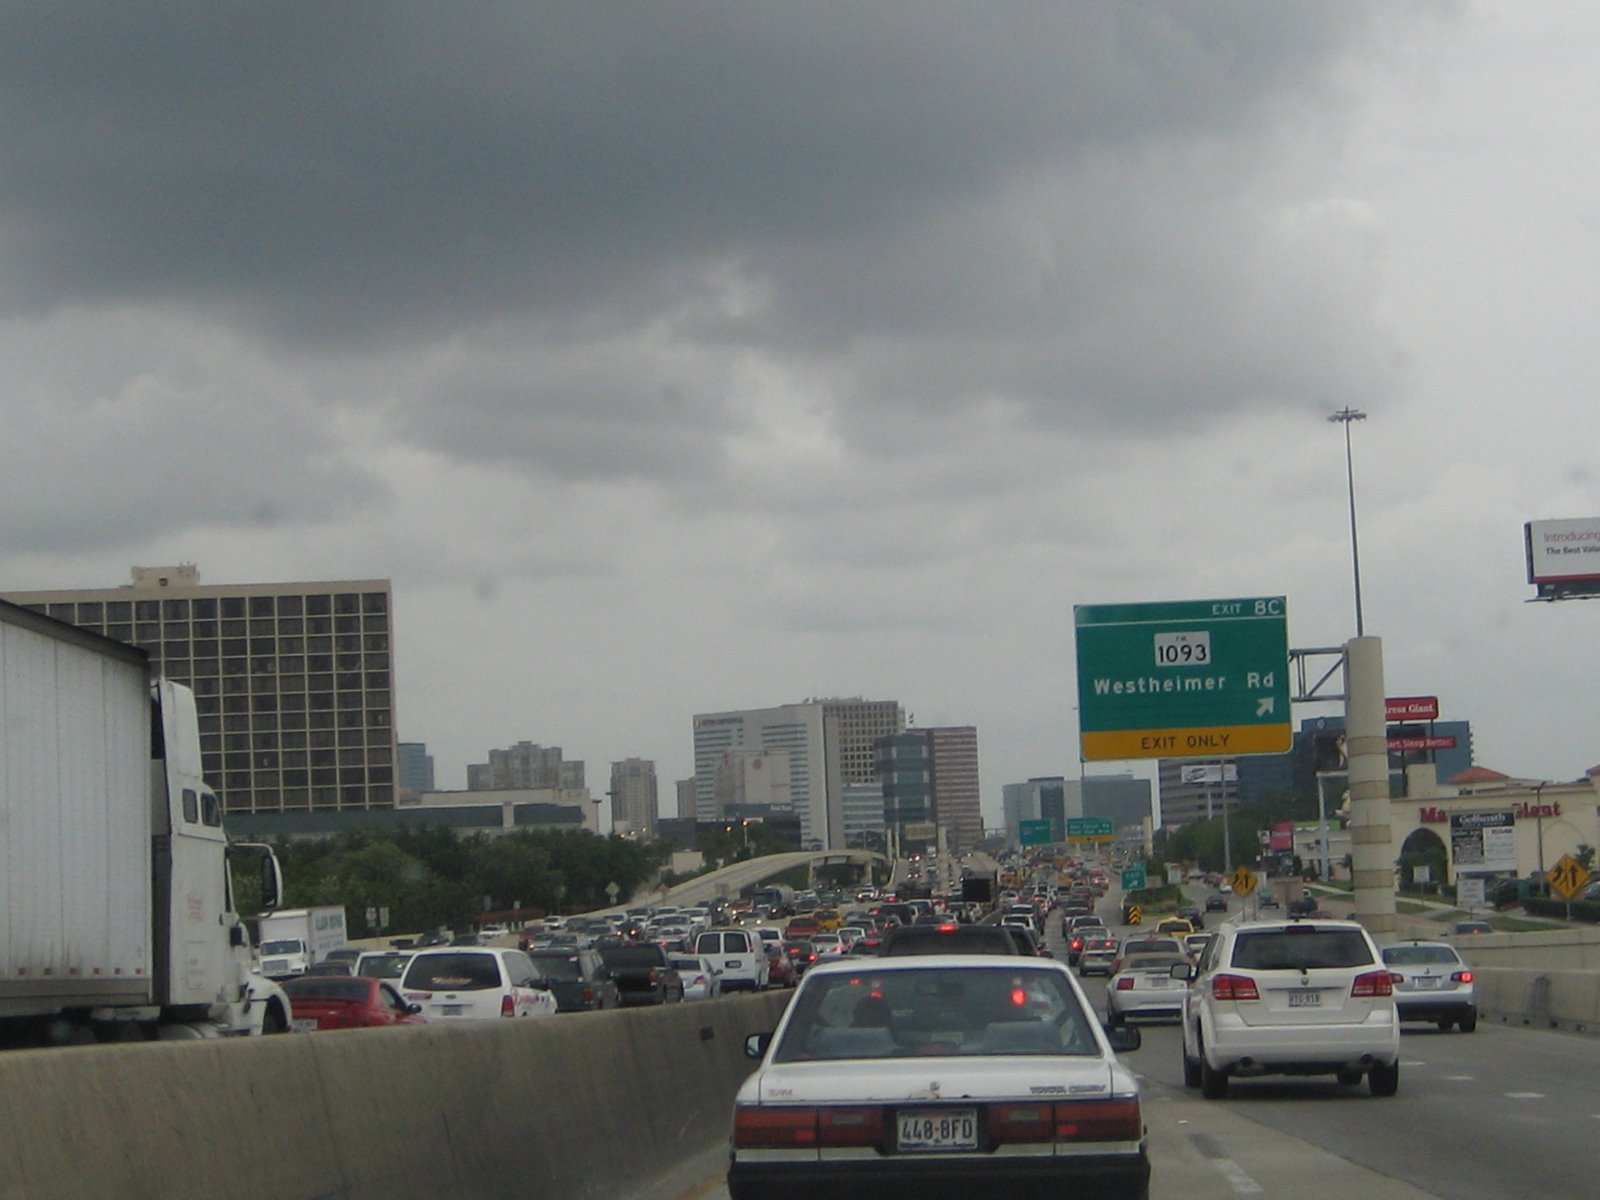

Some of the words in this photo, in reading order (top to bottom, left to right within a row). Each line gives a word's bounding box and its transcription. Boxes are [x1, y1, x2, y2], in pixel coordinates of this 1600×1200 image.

[1546, 546, 1561, 554] The
[1563, 546, 1580, 554] Best
[1212, 604, 1241, 615] EXIT
[1158, 644, 1207, 663] 1093
[1094, 676, 1226, 695] Westheimer
[1247, 672, 1274, 689] Rd
[1141, 736, 1176, 750] EXIT
[1187, 734, 1230, 748] ONLY
